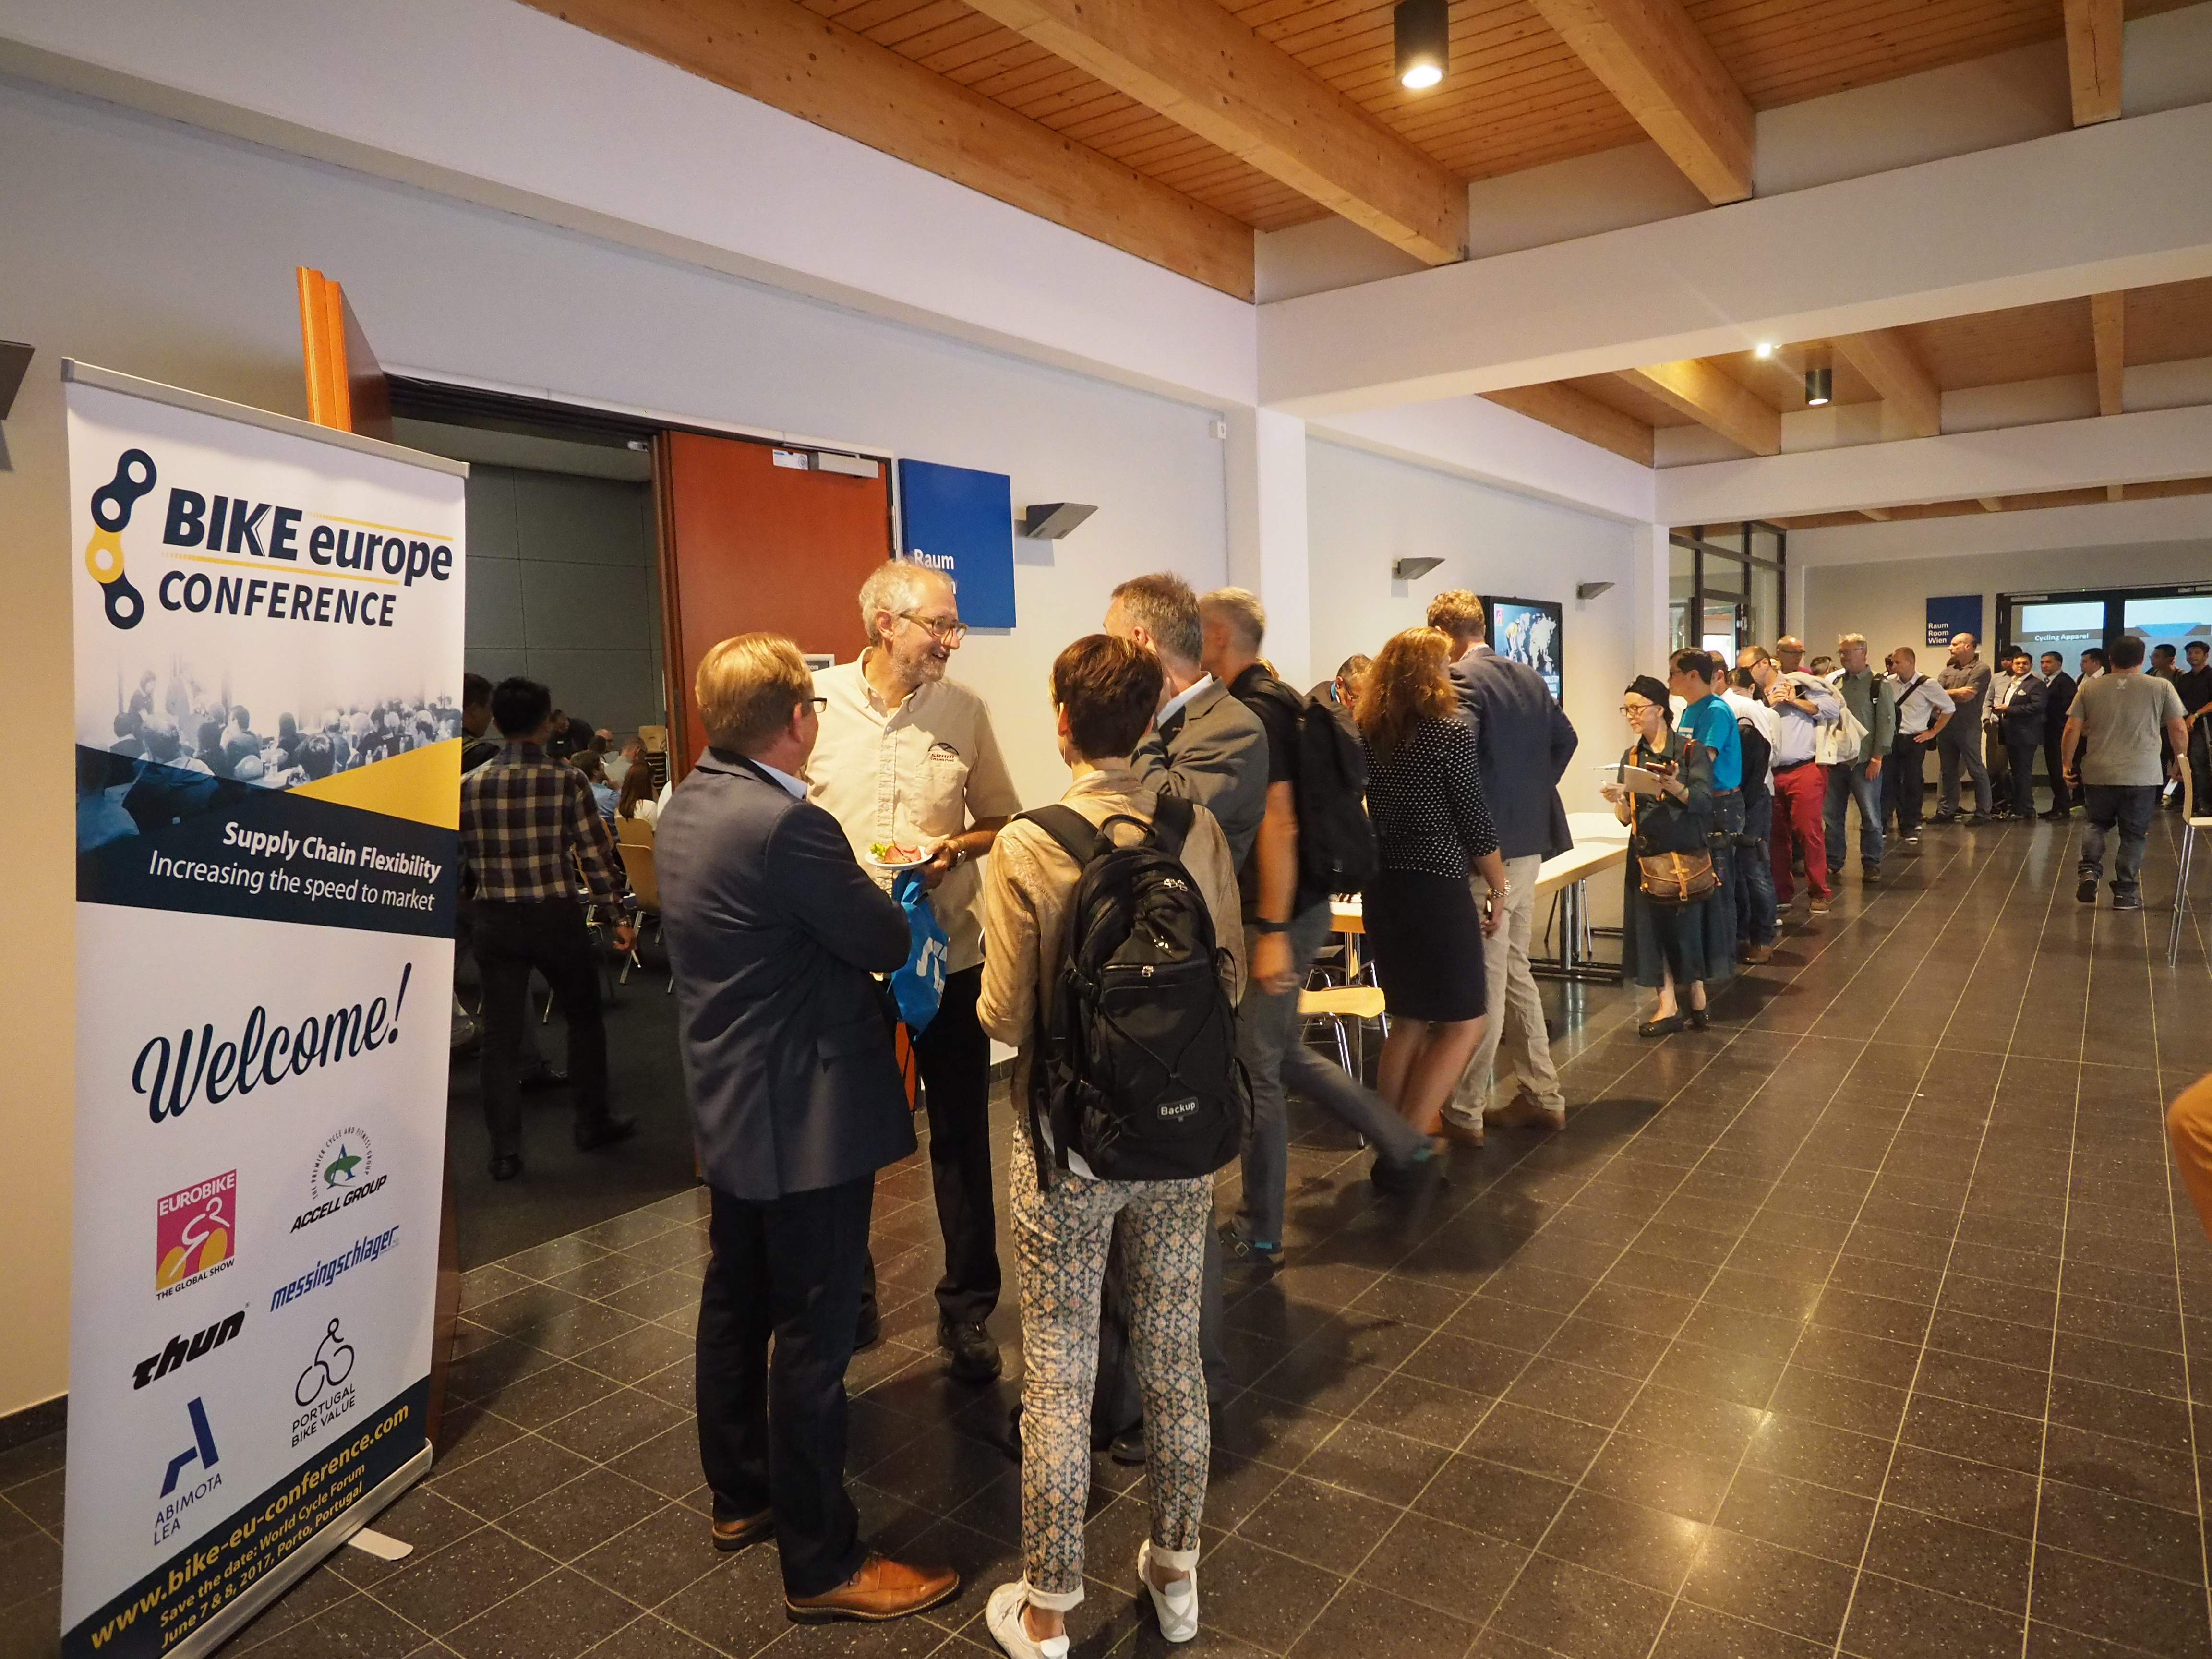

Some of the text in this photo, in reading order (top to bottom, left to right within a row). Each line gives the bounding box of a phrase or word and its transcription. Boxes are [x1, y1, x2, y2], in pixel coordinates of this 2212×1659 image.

[163, 487, 453, 587] BIKE europe
[914, 549, 954, 570] Raum
[159, 571, 397, 627] CONFERENCE
[150, 850, 435, 912] Increasing the speed to market
[223, 821, 442, 883] Supply Chain Flexibility
[132, 962, 412, 1124] Welcome!
[311, 1149, 325, 1183] PREMIER
[325, 1130, 342, 1148] CYCLE
[344, 1126, 355, 1135] AND
[159, 1173, 235, 1217] EUROBIKE
[290, 1174, 387, 1234] ACCELL GROUP
[156, 1259, 235, 1301] THE GLOBAL SHOW
[270, 1225, 399, 1313] messingschlager
[132, 1310, 245, 1390] thun
[291, 1395, 356, 1448] BIKE VALUE
[292, 1383, 356, 1433] PORTUGAL
[91, 1405, 409, 1649] www.bike-eu-conference.com
[155, 1473, 222, 1528] ABIMOTA
[154, 1521, 180, 1546] LEA
[160, 1464, 365, 1628] Save the date: World Cycle Forum
[161, 1482, 363, 1649] June 7 & 8, 2017, Porto, Portugal
